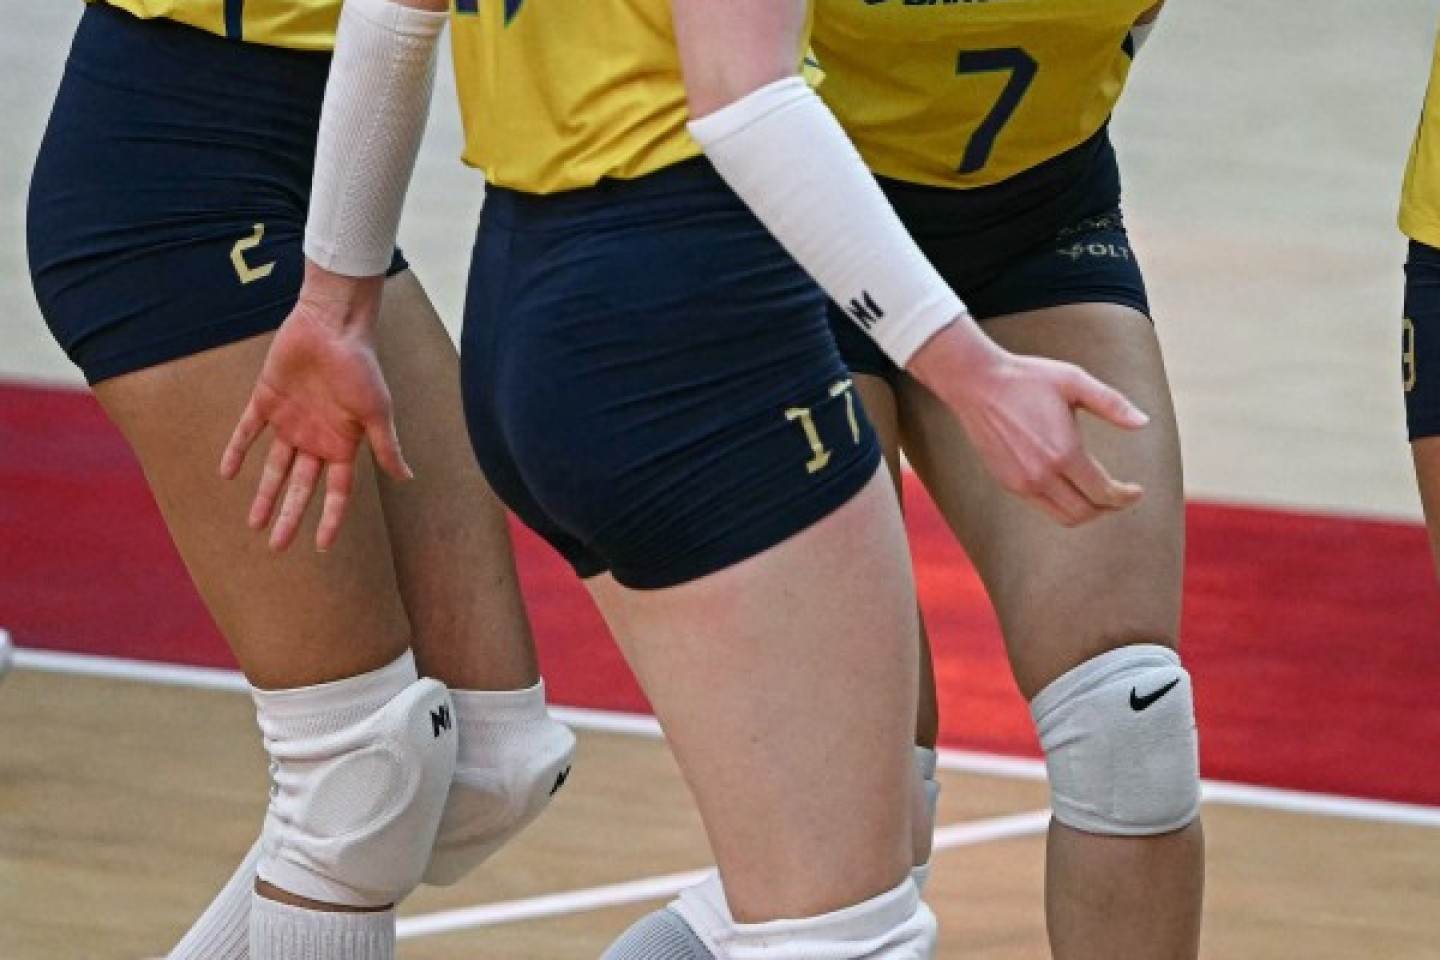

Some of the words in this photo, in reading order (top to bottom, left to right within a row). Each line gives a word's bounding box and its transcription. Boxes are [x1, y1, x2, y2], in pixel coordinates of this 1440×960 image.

[956, 46, 1039, 174] 7
[229, 222, 277, 284] 2
[785, 378, 861, 474] 17
